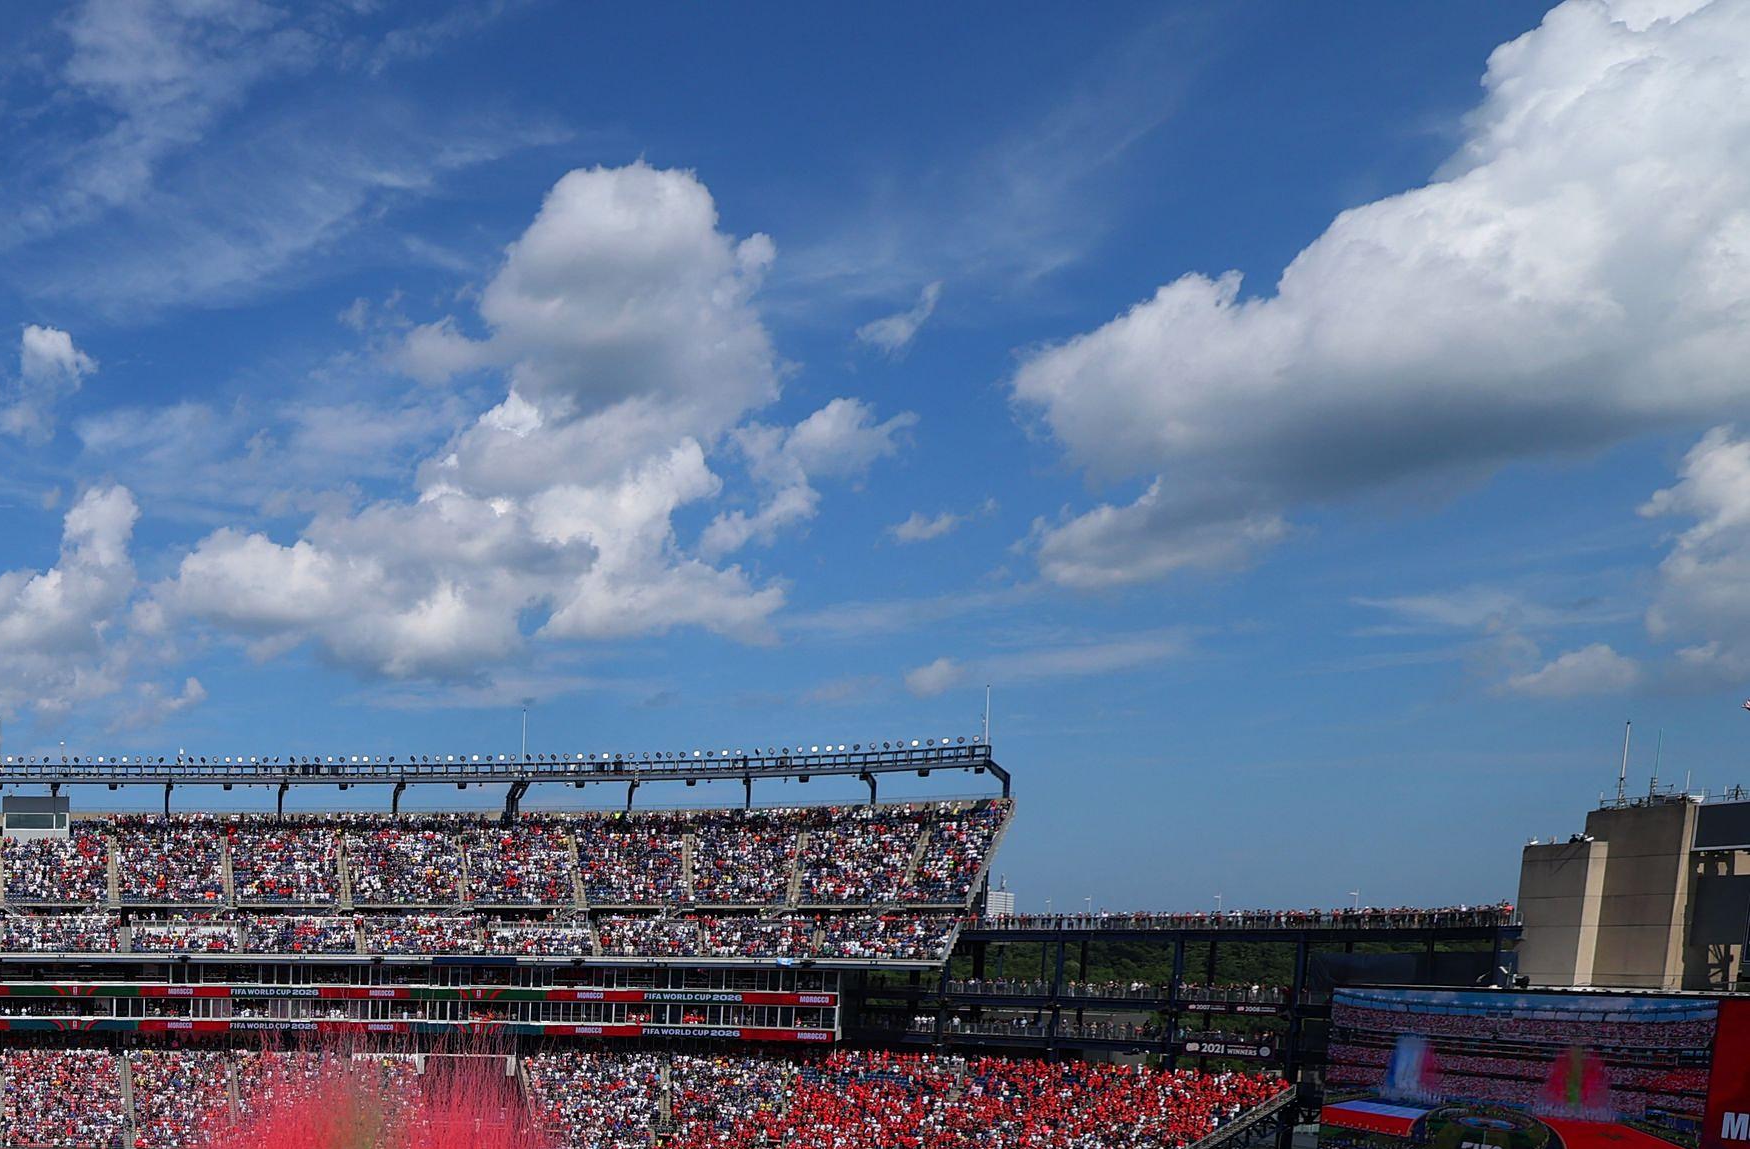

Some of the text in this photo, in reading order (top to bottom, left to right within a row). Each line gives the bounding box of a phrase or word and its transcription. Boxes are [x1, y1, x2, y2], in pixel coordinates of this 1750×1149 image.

[800, 996, 829, 1004] MOROCCO
[230, 1022, 318, 1030] FIFA WORLD CUP 2026
[661, 1028, 691, 1036] WORLD
[1201, 1043, 1225, 1054] 2021
[1227, 1048, 1257, 1056] WINNERS
